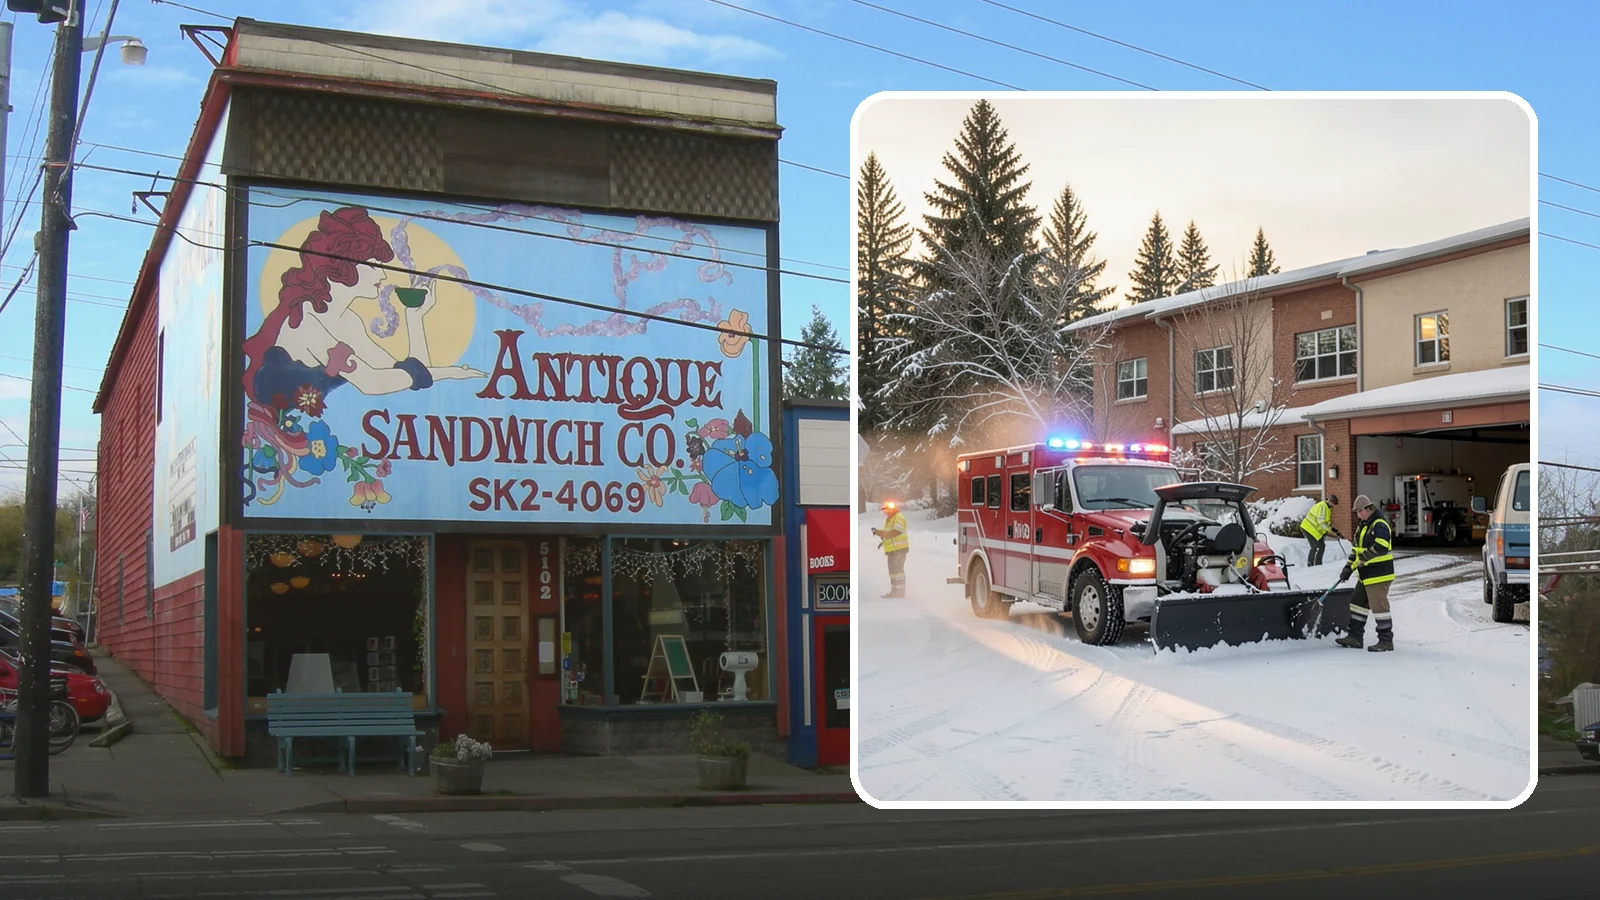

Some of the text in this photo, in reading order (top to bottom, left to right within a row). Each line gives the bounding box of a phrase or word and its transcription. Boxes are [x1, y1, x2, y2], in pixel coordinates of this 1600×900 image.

[475, 329, 724, 420] ANTIQUE
[361, 408, 685, 469] SANDWICH CO.
[468, 477, 645, 513] SK2-4069
[540, 541, 552, 599] 5102
[809, 555, 835, 569] BOOKS
